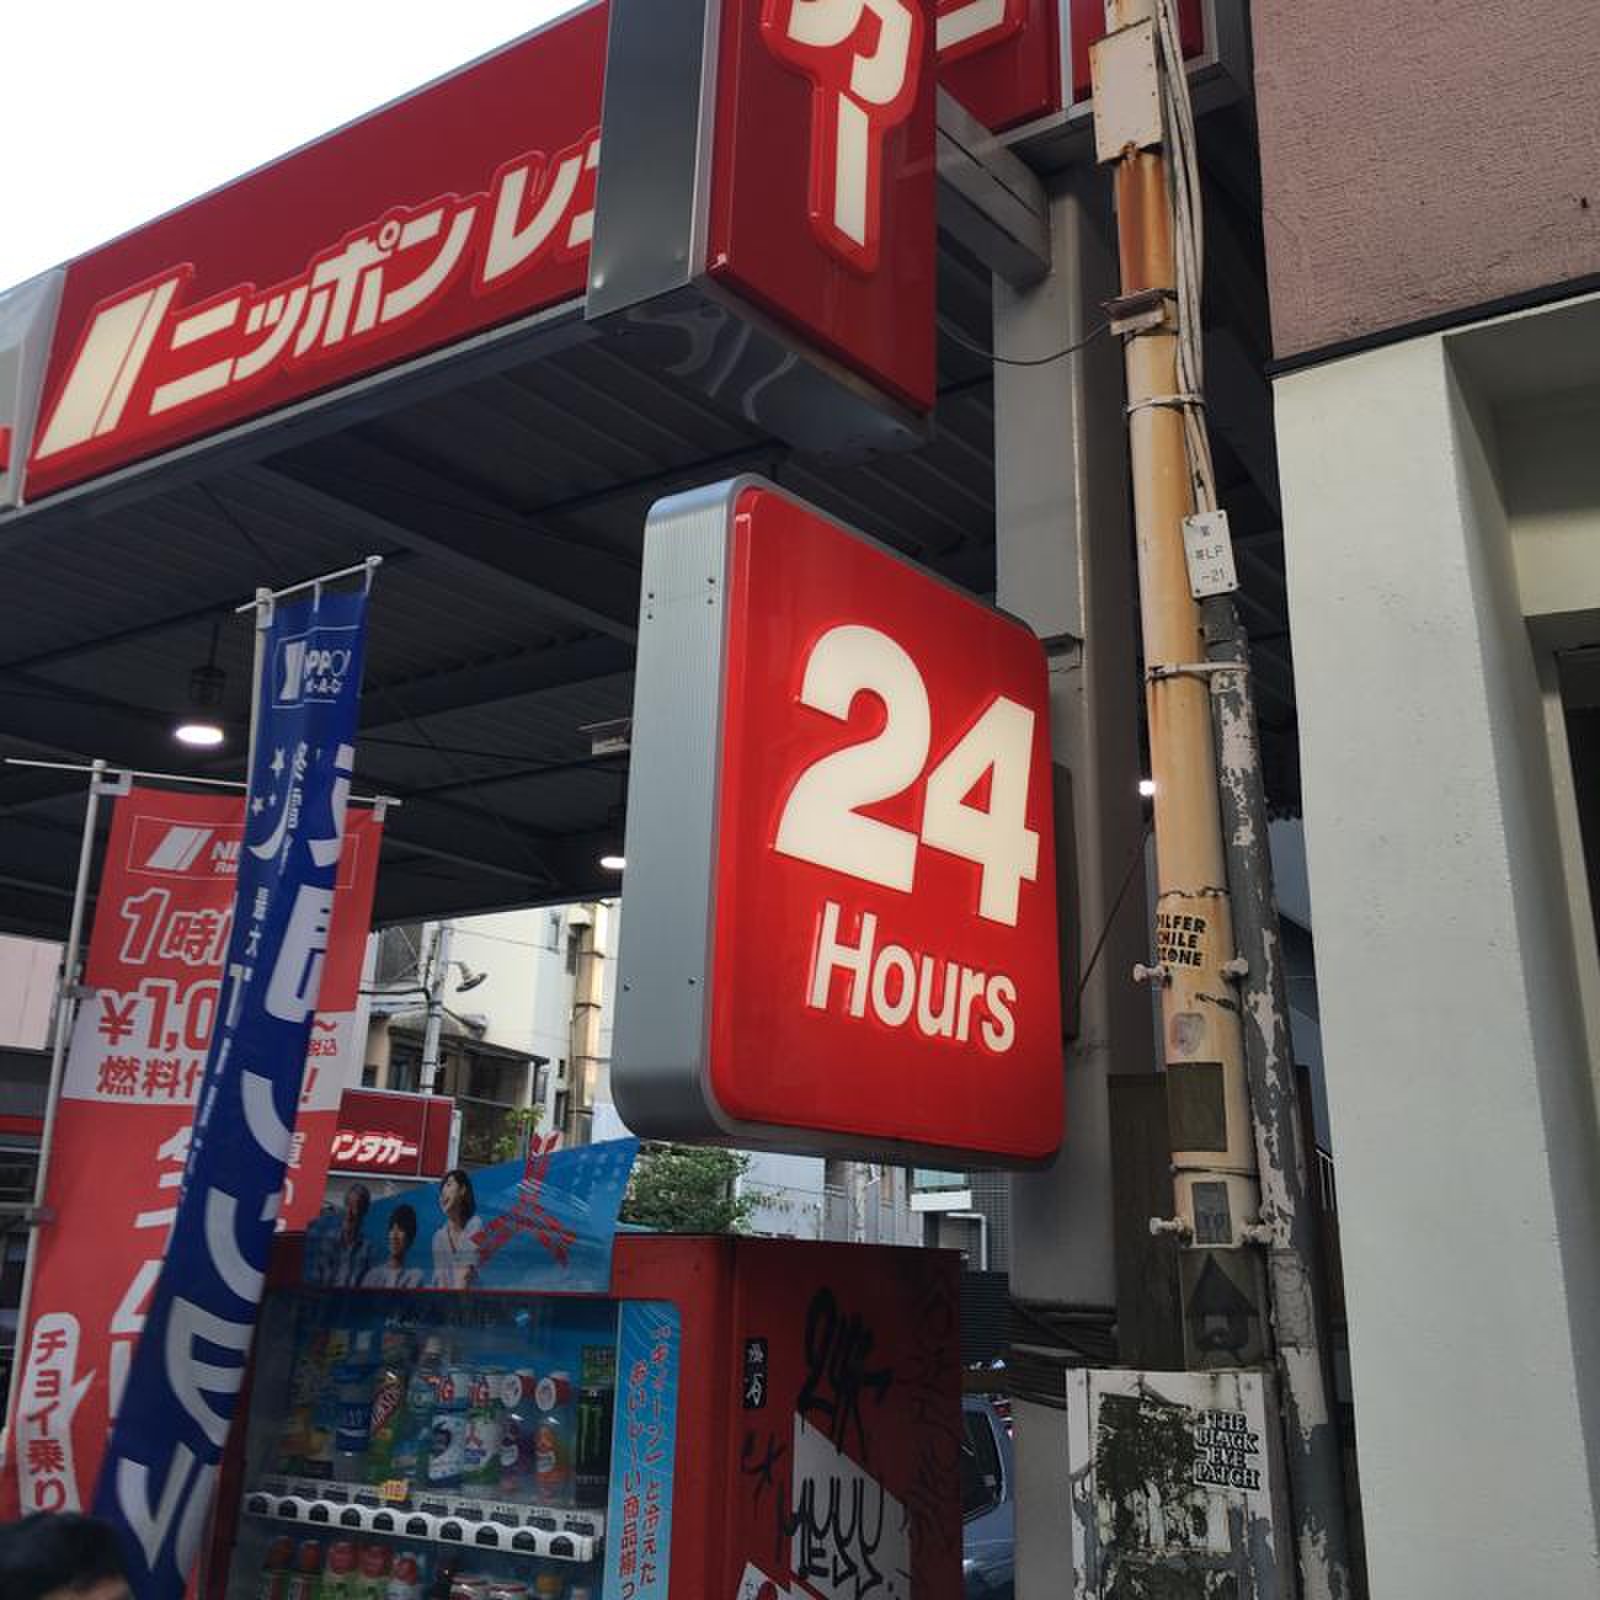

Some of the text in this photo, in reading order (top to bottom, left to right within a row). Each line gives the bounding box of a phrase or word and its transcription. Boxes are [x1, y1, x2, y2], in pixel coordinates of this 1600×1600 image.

[775, 624, 1040, 927] 24
[120, 886, 235, 966] 1時
[805, 900, 1019, 1053] Hours
[1155, 913, 1206, 934] ILFER
